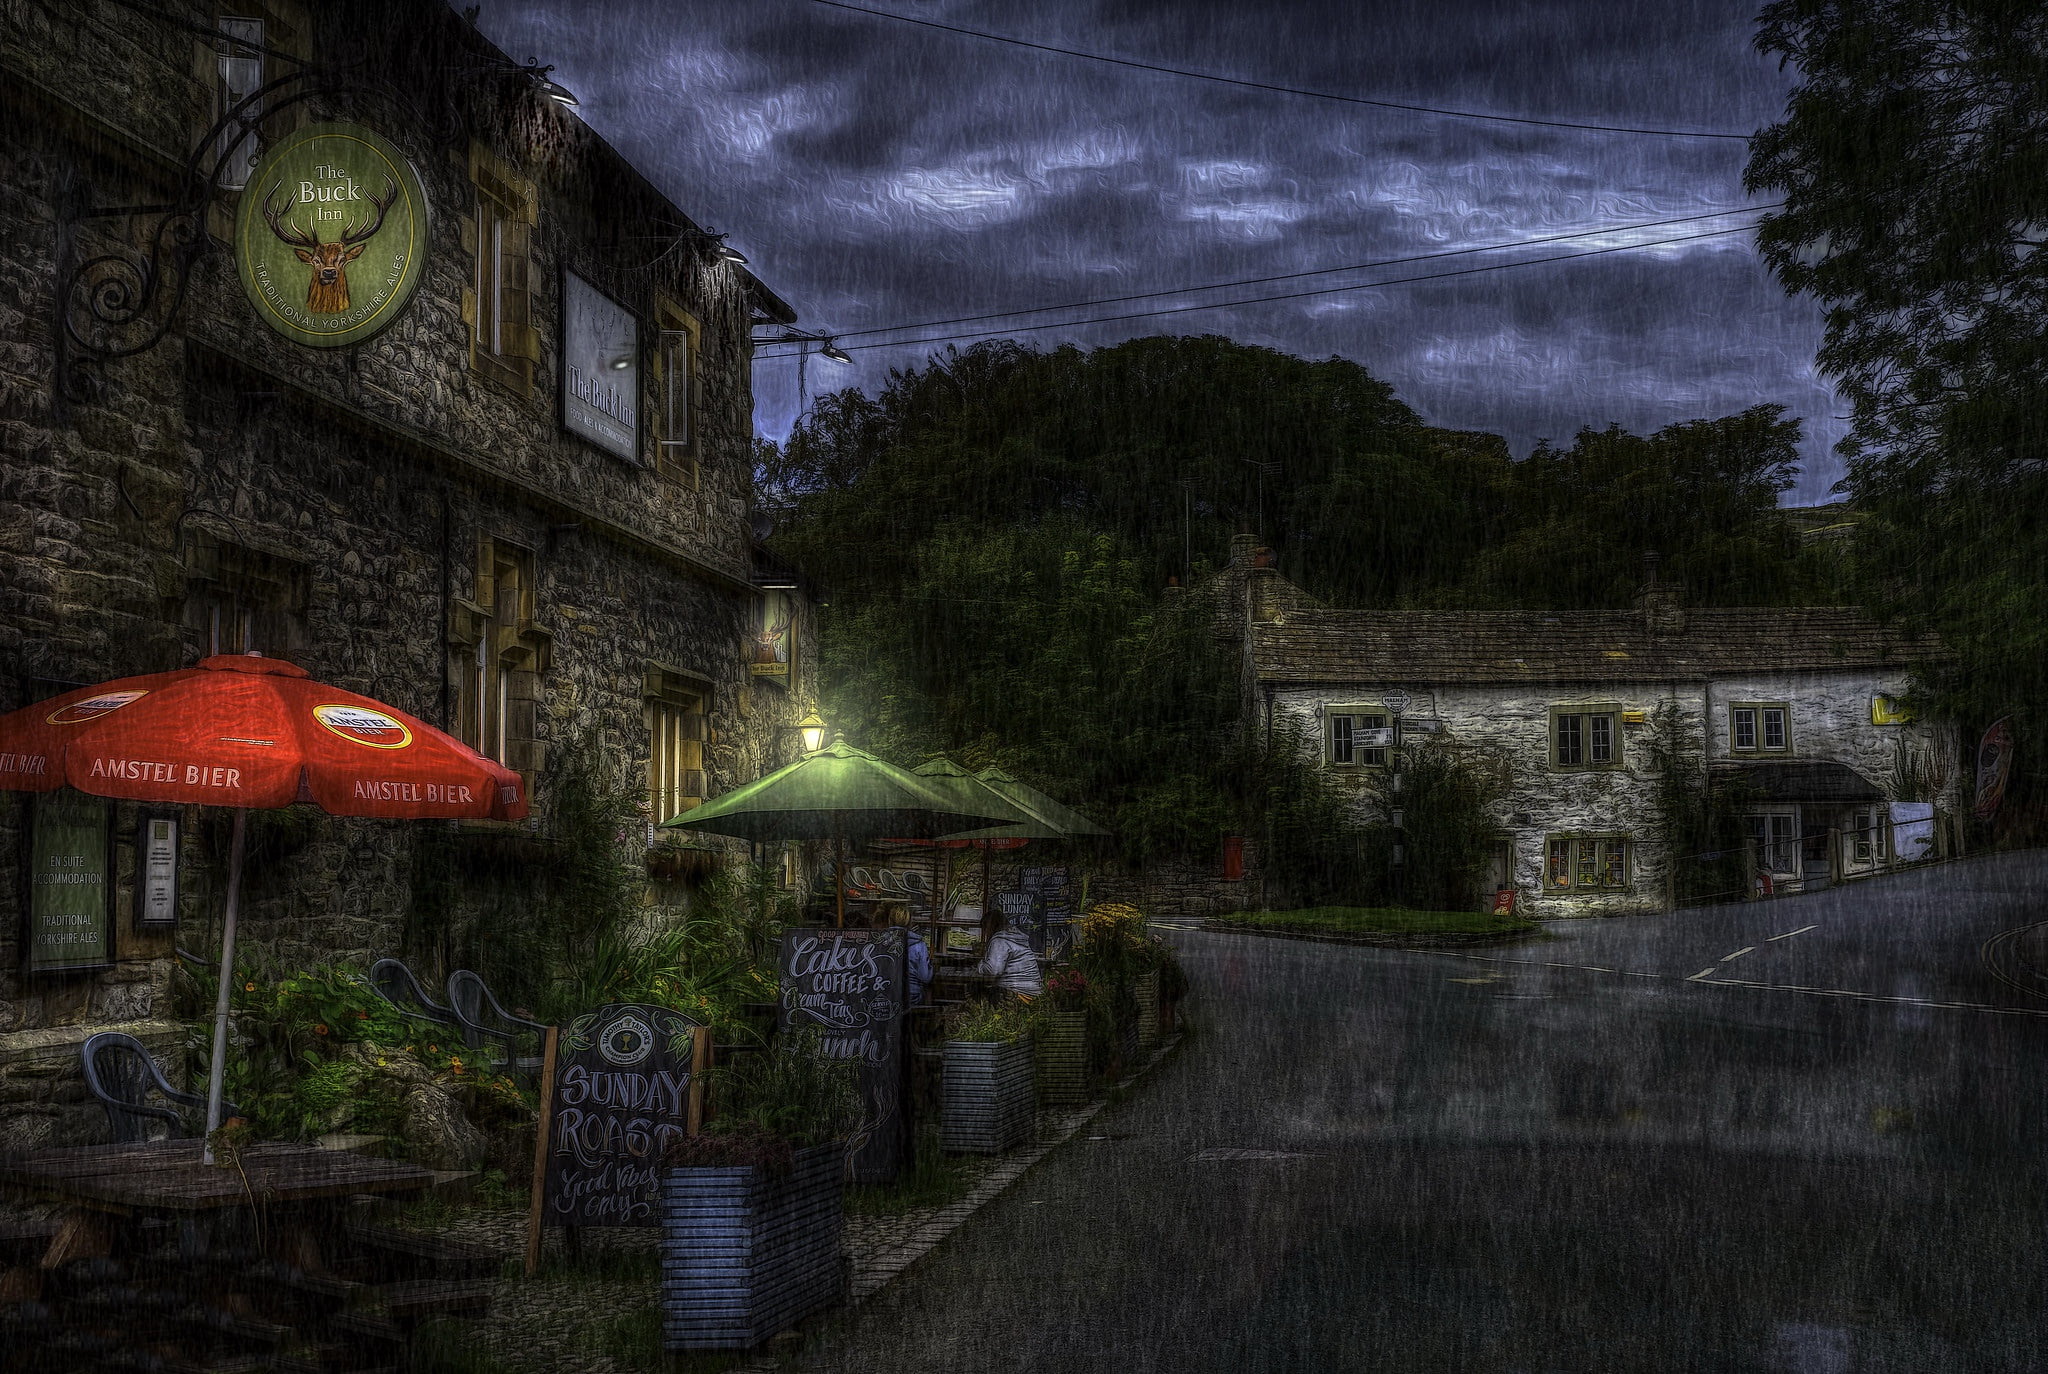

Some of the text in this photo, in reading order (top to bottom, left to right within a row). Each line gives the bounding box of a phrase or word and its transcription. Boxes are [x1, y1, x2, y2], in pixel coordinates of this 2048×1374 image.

[315, 164, 345, 179] The
[299, 178, 361, 203] Buck
[317, 208, 343, 221] Inn
[256, 254, 405, 329] TRADITIONAL YORKSHIRE ALES
[568, 364, 635, 429] The Buck Inn
[327, 717, 393, 727] AMSTEL
[352, 727, 386, 736] BIER
[20, 754, 46, 775] BIER
[90, 758, 241, 788] AMSTEL BIER
[354, 780, 473, 803] AMSTEL BIER
[50, 856, 84, 867] EN SUITE
[33, 872, 102, 885] ACCOMMODATION
[998, 893, 1034, 905] SUNDAY
[1003, 904, 1030, 914] LUNCH
[42, 914, 92, 927] TRADITIONAL
[35, 931, 98, 945] YORKSHIRE ALES
[789, 936, 890, 978] Cakes
[813, 972, 891, 994] COFFEE &
[781, 987, 828, 1010] Cream
[824, 999, 854, 1024] Teas
[602, 1021, 624, 1044] TIMOTHY
[605, 1046, 632, 1059] CHAMPION
[818, 1029, 890, 1061] unch
[560, 1064, 690, 1118] SUNDAY
[554, 1108, 684, 1168] ROAST
[554, 1161, 614, 1214] Good
[616, 1163, 660, 1192] Vibes
